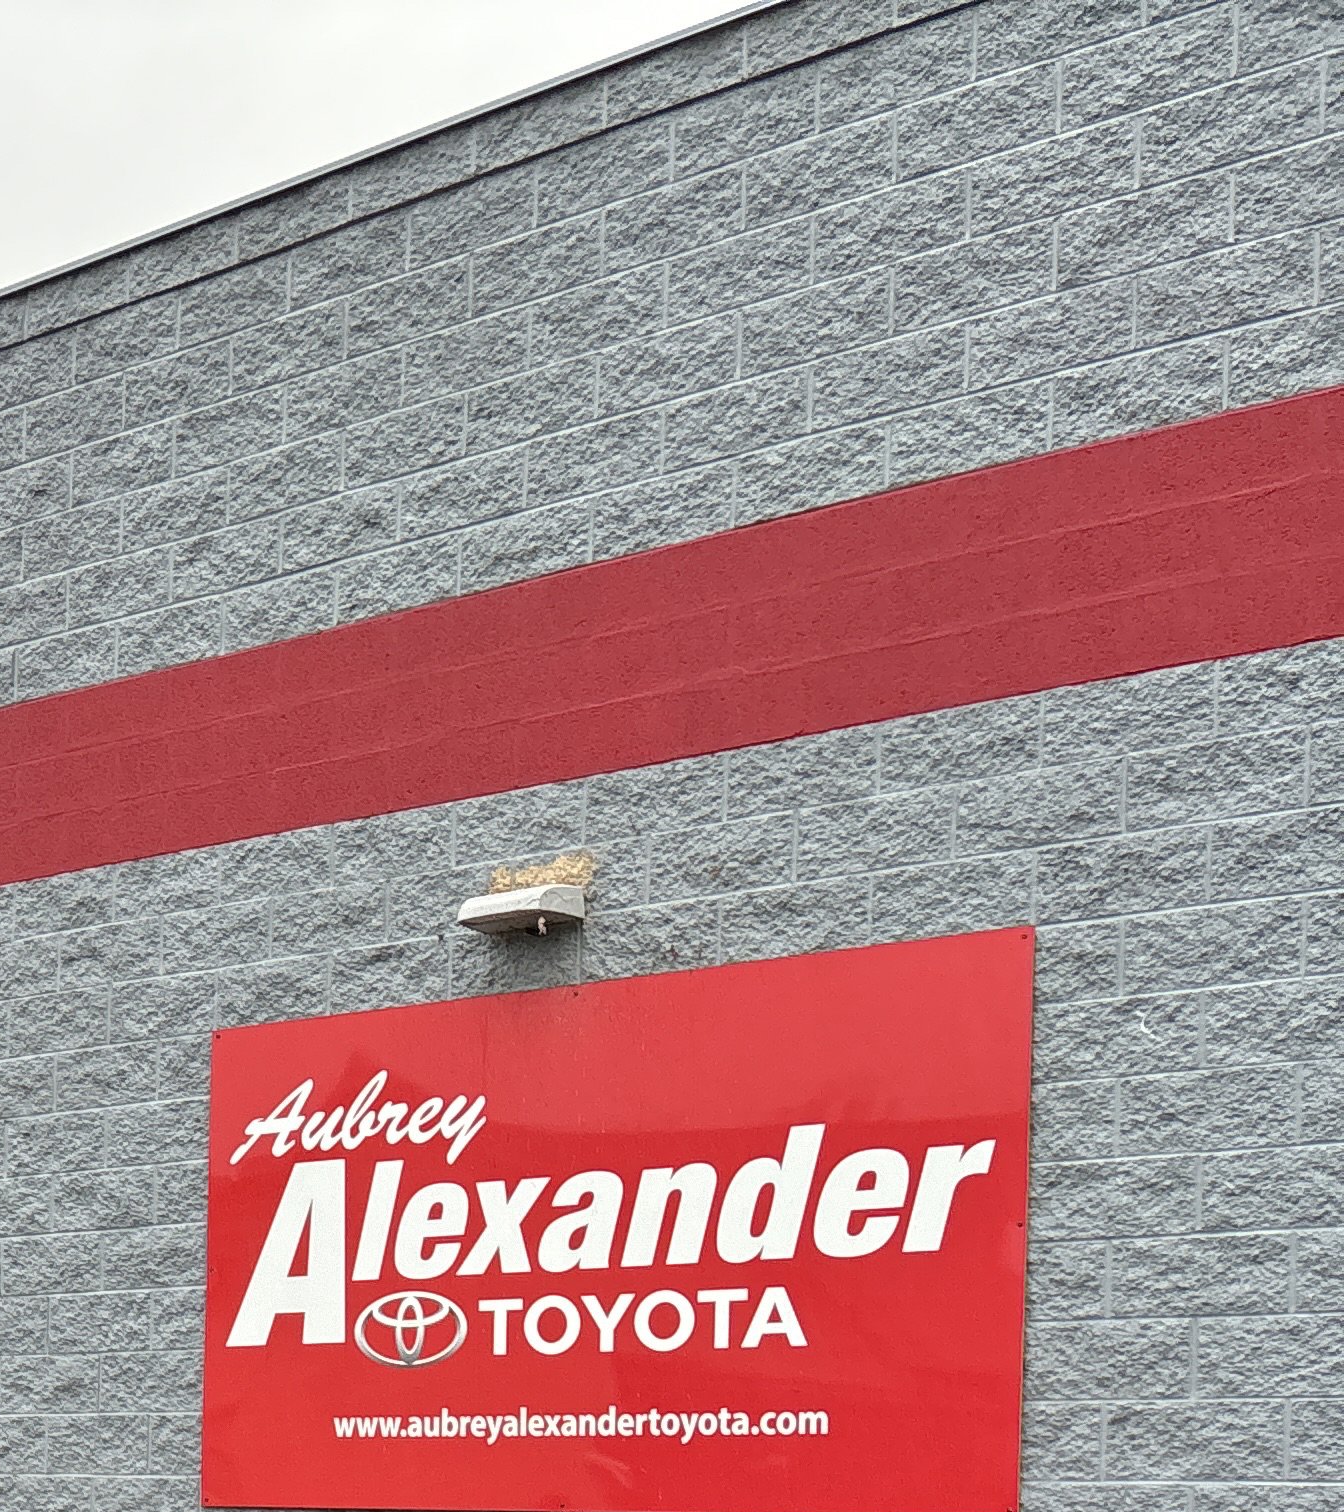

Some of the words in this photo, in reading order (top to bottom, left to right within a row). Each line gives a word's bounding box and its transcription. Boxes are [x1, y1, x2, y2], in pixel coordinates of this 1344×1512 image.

[229, 1069, 487, 1165] Aubrey
[225, 1123, 997, 1348] Alexander
[478, 1286, 808, 1356] TOYOTA
[333, 1405, 829, 1446] www.aubreyalexandertoyota.com
